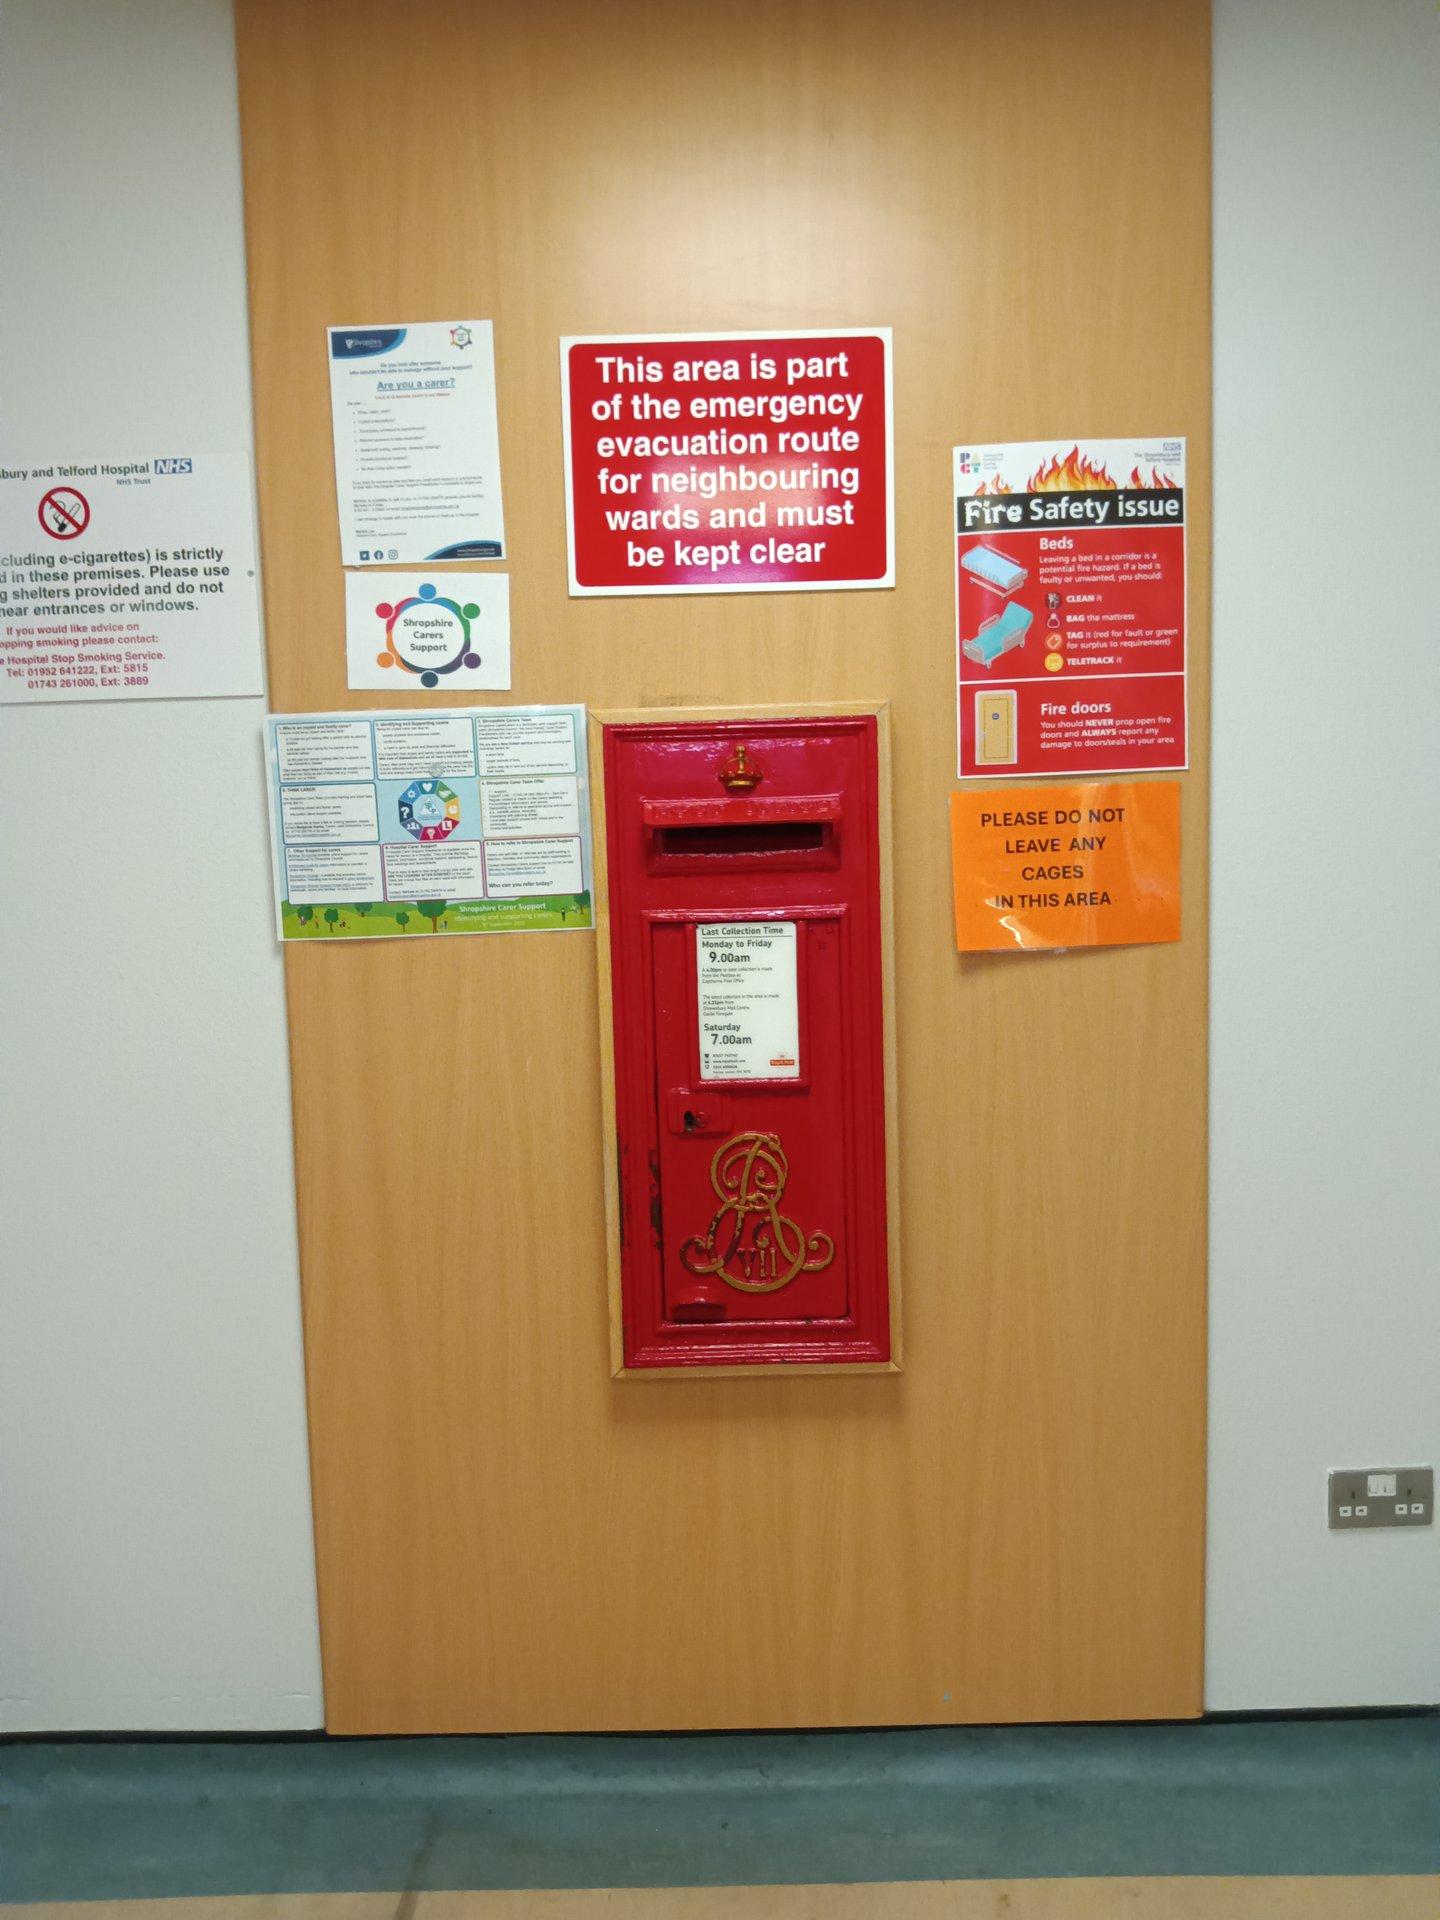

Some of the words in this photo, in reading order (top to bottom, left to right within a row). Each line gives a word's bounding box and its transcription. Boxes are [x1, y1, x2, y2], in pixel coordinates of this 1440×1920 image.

[596, 357, 663, 382] This
[673, 358, 740, 381] area
[751, 353, 776, 379] is
[787, 352, 848, 385] part
[377, 382, 393, 390] Are
[396, 382, 413, 390] you
[426, 378, 455, 387] carer?
[592, 394, 622, 420] of
[632, 393, 680, 419] the
[690, 394, 863, 422] emergency
[597, 428, 767, 457] evacuation
[778, 427, 859, 452] route
[32, 465, 54, 477] and
[57, 464, 97, 476] Telford
[101, 463, 149, 476] Hospital
[155, 459, 192, 474] NHS
[598, 468, 641, 494] for
[651, 463, 859, 498] neighbouring
[605, 504, 699, 530] wards
[710, 502, 766, 528] and
[777, 500, 854, 526] must
[964, 500, 1022, 527] Fire
[1030, 497, 1109, 523] Safety
[1118, 495, 1179, 517] issue
[1040, 538, 1073, 549] Beds
[60, 550, 150, 566] e-cigarettes)
[155, 549, 168, 561] is
[173, 547, 223, 562] strictly
[627, 542, 664, 566] be
[675, 540, 740, 571] kept
[750, 538, 825, 564] clear
[1039, 556, 1069, 564] Leaving
[1078, 553, 1093, 562] bed
[1095, 553, 1102, 561] in
[12, 571, 24, 583] in
[29, 569, 68, 582] these
[74, 567, 144, 583] premises.
[150, 564, 198, 577] Please
[204, 566, 230, 575] use
[1040, 565, 1075, 575] potential
[1077, 564, 1090, 572] fire
[1123, 562, 1128, 570] If
[1138, 562, 1152, 570] bed
[1040, 575, 1062, 585] faulty
[1074, 573, 1116, 582] unwanted,
[1118, 573, 1133, 582] you
[1135, 572, 1162, 580] should:
[13, 586, 70, 600] shelters
[75, 582, 139, 600] provided
[144, 583, 172, 594] and
[176, 582, 194, 593] do
[200, 581, 224, 593] not
[1066, 595, 1094, 603] CLEAN
[0, 606, 28, 617] near
[34, 603, 105, 615] entrances
[110, 603, 125, 613] or
[130, 599, 199, 612] windows.
[7, 627, 13, 635] If
[16, 628, 34, 636] you
[37, 625, 67, 634] would
[70, 624, 87, 633] like
[91, 623, 123, 632] advice
[404, 619, 453, 628] Shropshire
[1093, 630, 1109, 638] (red
[1125, 629, 1143, 637] fault
[1156, 628, 1178, 636] green
[36, 637, 78, 649] smoking
[82, 636, 115, 646] please
[118, 635, 159, 644] contact:
[410, 644, 447, 652] Support
[1067, 641, 1078, 649] for
[1080, 640, 1108, 649] surplus
[1120, 638, 1170, 648] requirement)
[8, 654, 48, 665] Hospital
[52, 653, 75, 664] Stop
[78, 653, 122, 663] Smoking
[126, 652, 166, 661] Service.
[1067, 657, 1114, 666] TELETRACK
[7, 668, 24, 677] Tel:
[28, 667, 57, 676] 01952
[60, 666, 98, 676] 641222,
[101, 665, 120, 674] Ext:
[124, 664, 148, 672] 5815
[28, 680, 57, 689] 01743
[60, 679, 98, 688] 261000,
[101, 678, 120, 686] Ext:
[124, 676, 148, 686] 3889
[1041, 703, 1066, 715] Fire
[1072, 702, 1111, 714] doors
[1058, 720, 1083, 728] should
[1116, 719, 1134, 728] prop
[1136, 718, 1156, 726] open
[1158, 716, 1171, 724] fire
[1040, 731, 1062, 739] doors
[1119, 728, 1143, 737] report
[1041, 741, 1072, 749] damage
[1138, 737, 1155, 746] your
[981, 812, 1048, 827] PLEASE
[1055, 810, 1081, 824] DO
[1089, 808, 1125, 822] NOT
[1006, 839, 1060, 854] LEAVE
[1069, 837, 1106, 851] ANY
[1022, 866, 1083, 881] CAGES
[996, 895, 1013, 908] IN
[1018, 894, 1059, 907] THIS
[1064, 892, 1111, 906] AREA
[519, 903, 546, 911] Support
[702, 928, 718, 936] Last
[722, 927, 760, 935] Collection
[702, 941, 733, 949] Monday
[748, 940, 772, 948] Friday
[709, 952, 750, 963] 9.00am
[711, 1034, 752, 1044] 7.00am
